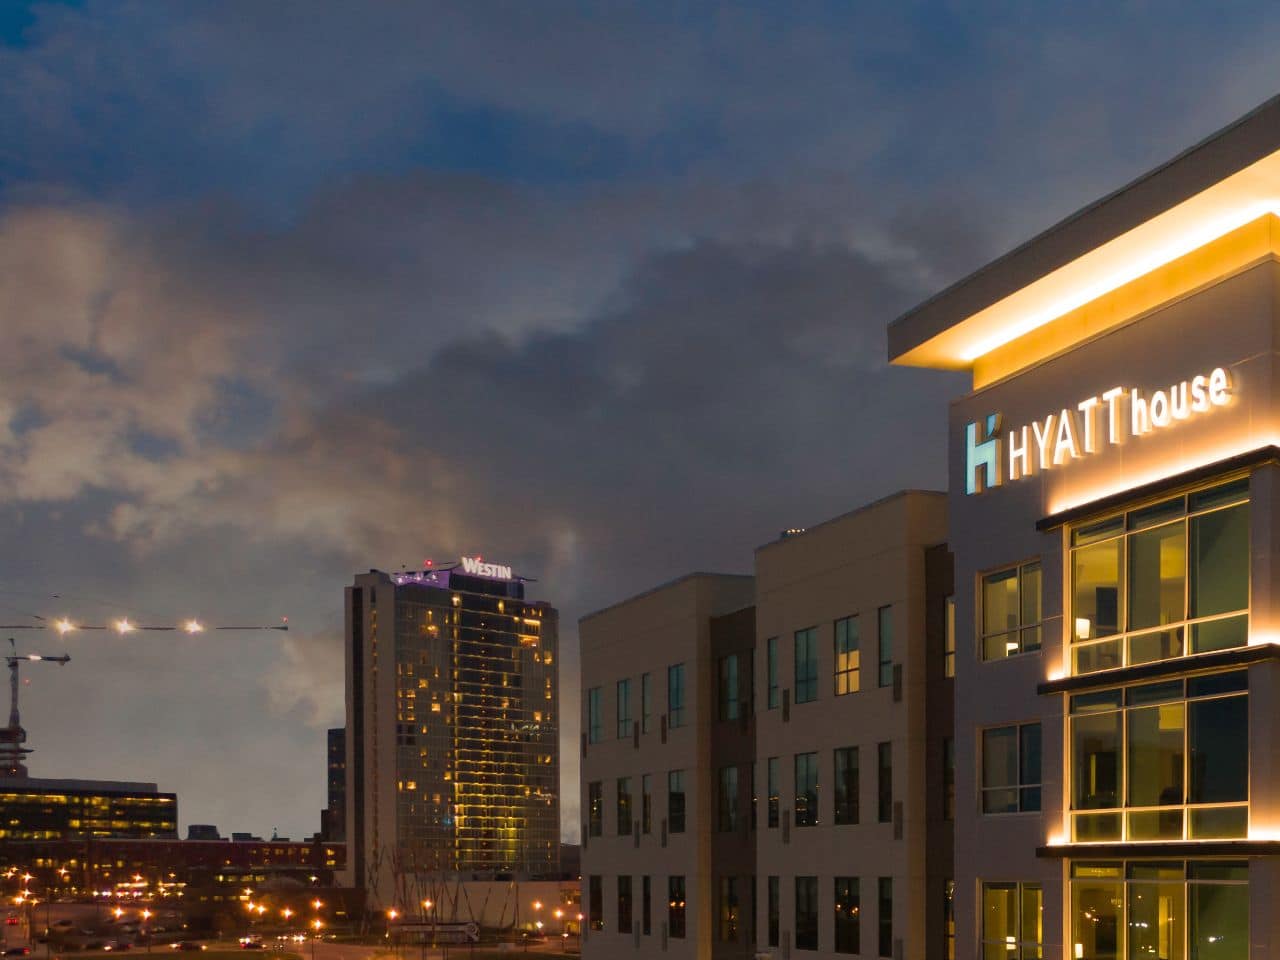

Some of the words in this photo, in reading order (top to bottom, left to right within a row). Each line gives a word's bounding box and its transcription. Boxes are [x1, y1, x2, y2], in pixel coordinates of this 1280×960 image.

[1009, 386, 1125, 480] HYATT
[1131, 367, 1232, 436] house
[461, 556, 512, 579] WESTIN
